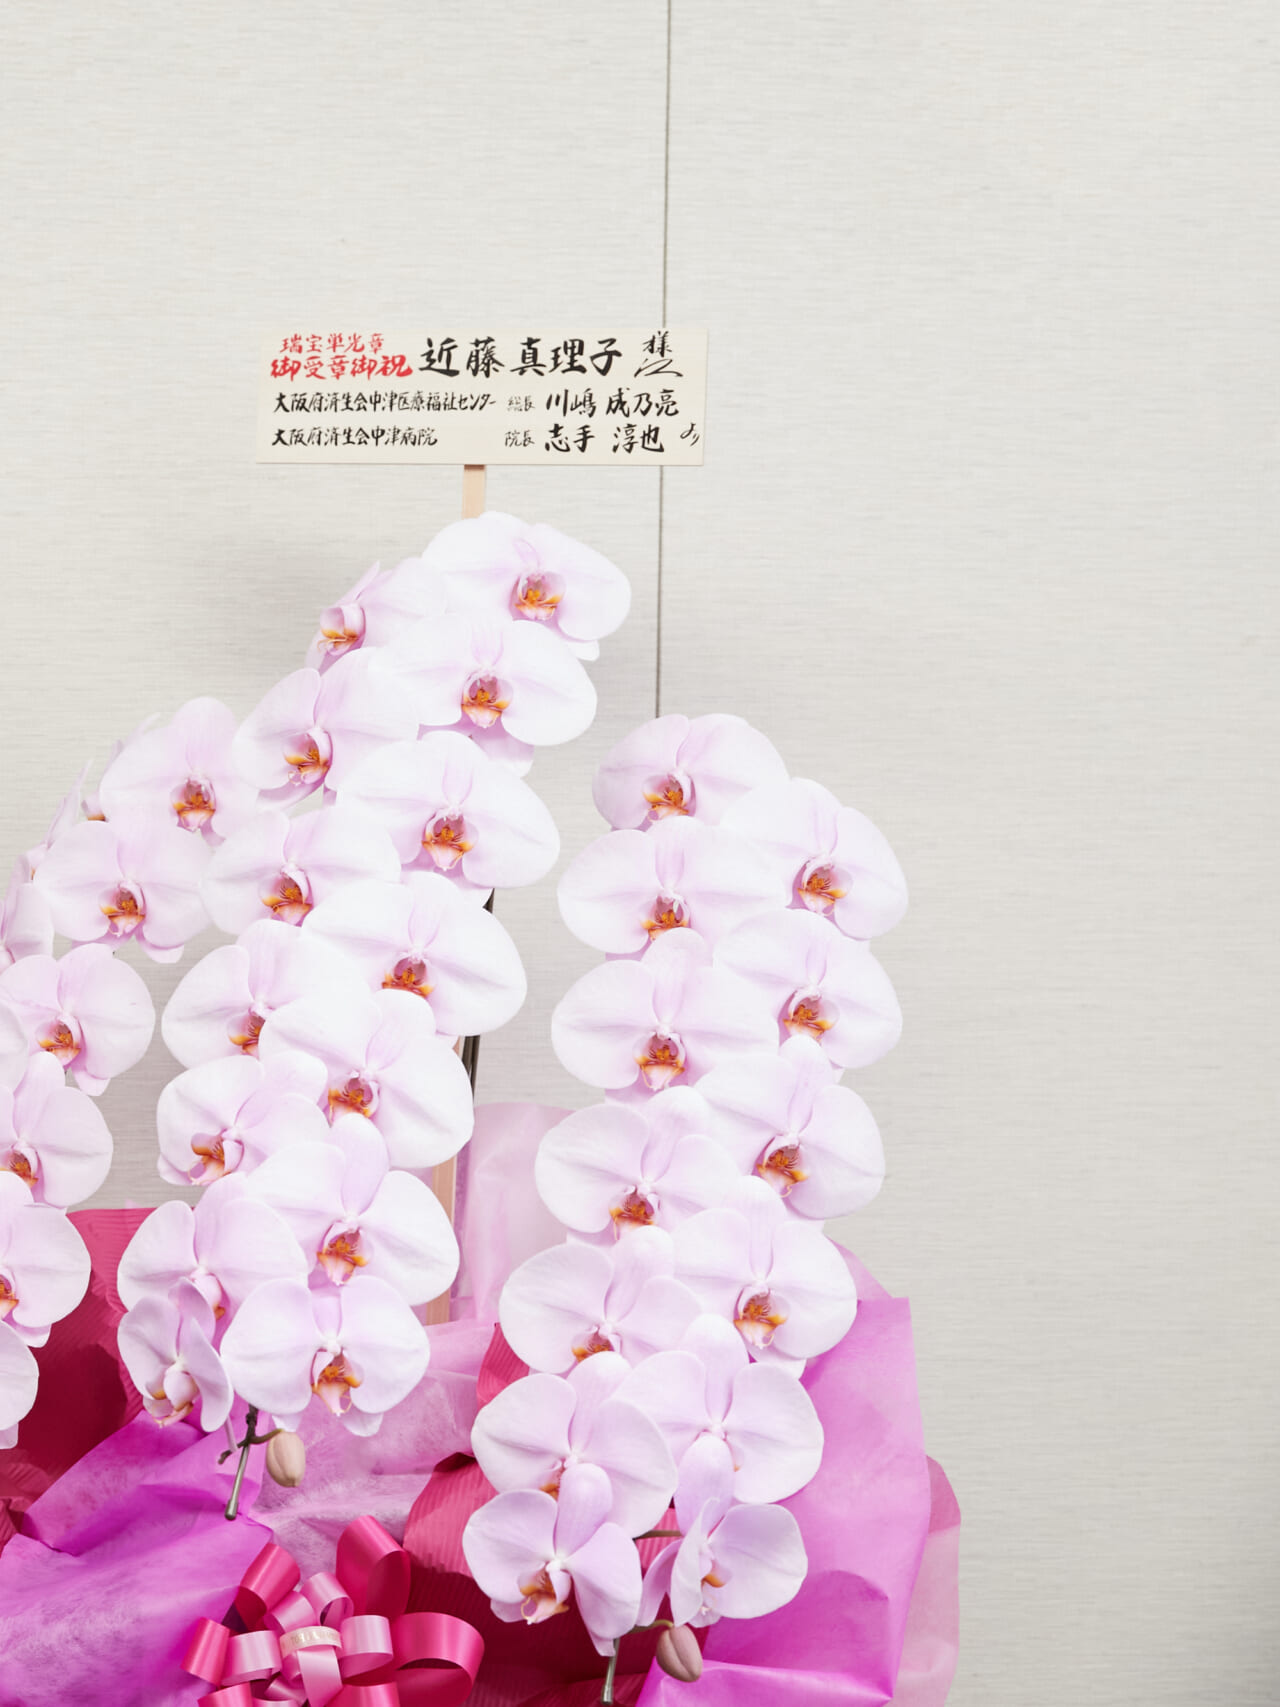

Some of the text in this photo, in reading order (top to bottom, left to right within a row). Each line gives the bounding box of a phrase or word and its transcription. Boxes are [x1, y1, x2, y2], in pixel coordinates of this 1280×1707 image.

[270, 353, 413, 382] 御受章御祝
[418, 336, 622, 379] 近藤真理子
[272, 425, 438, 447] 大阪府済生会中津病院
[545, 423, 595, 453] 志手
[612, 423, 664, 454] 淳也
